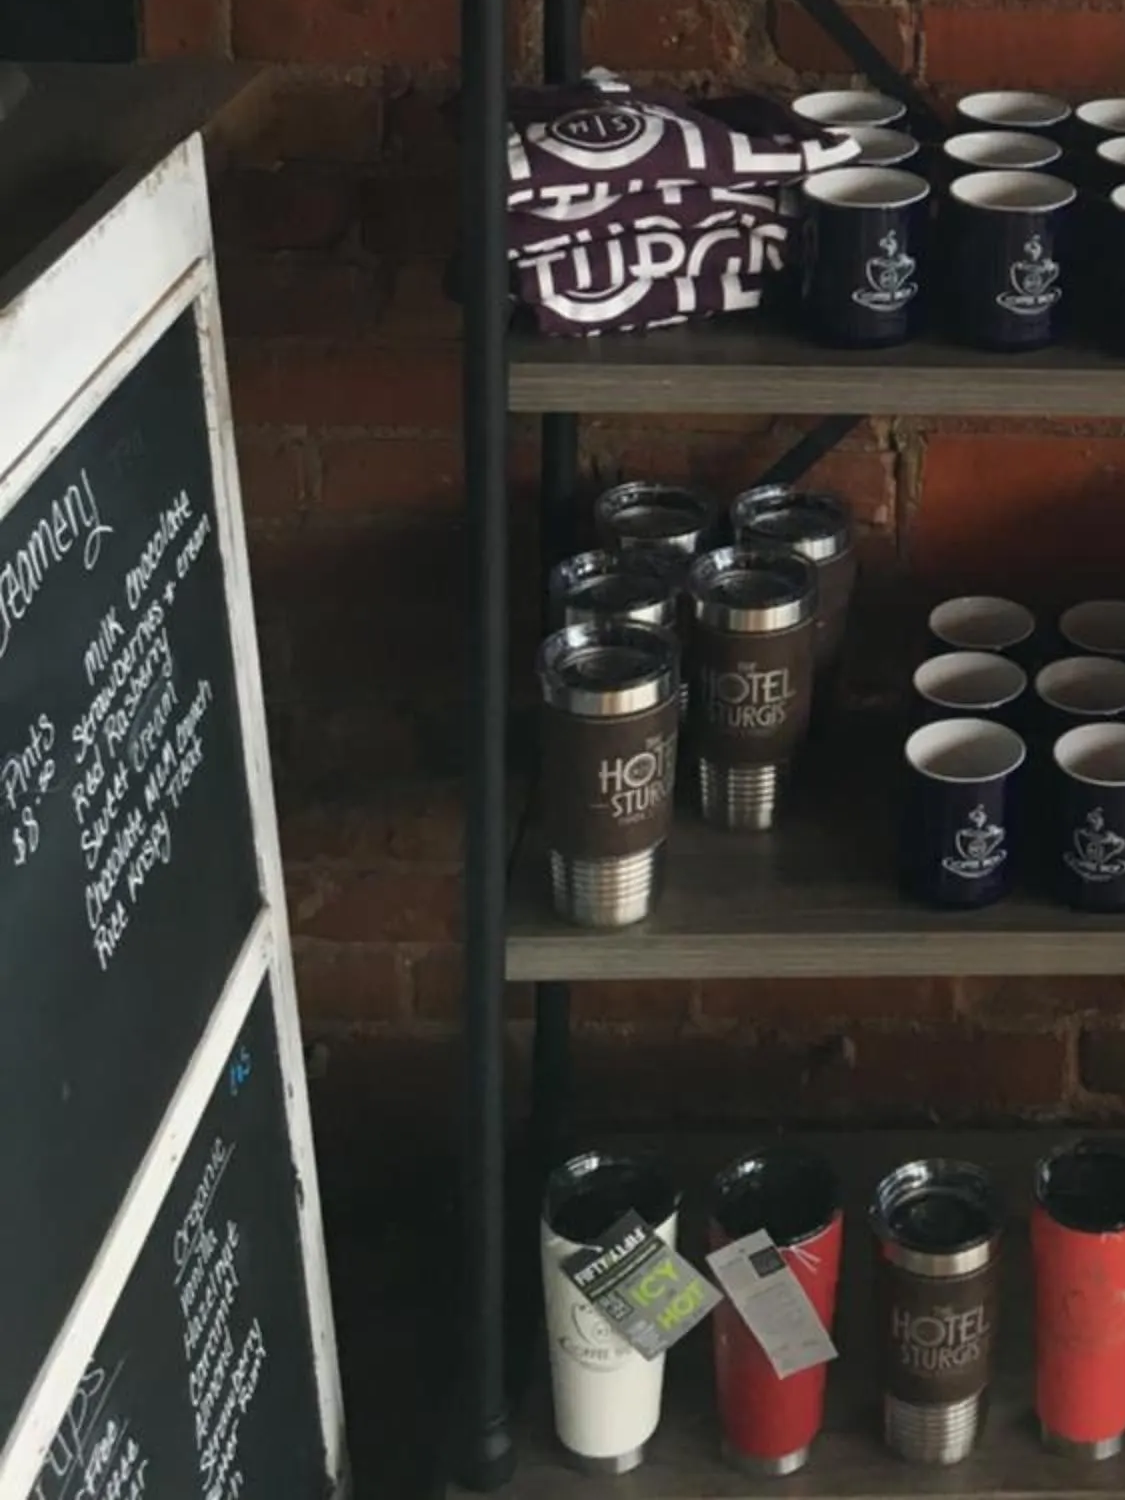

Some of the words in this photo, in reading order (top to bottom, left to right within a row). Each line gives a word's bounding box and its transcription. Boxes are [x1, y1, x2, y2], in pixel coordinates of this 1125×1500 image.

[630, 1256, 681, 1308] ICY
[655, 1277, 706, 1332] HOT
[892, 1299, 992, 1347] HOTEL
